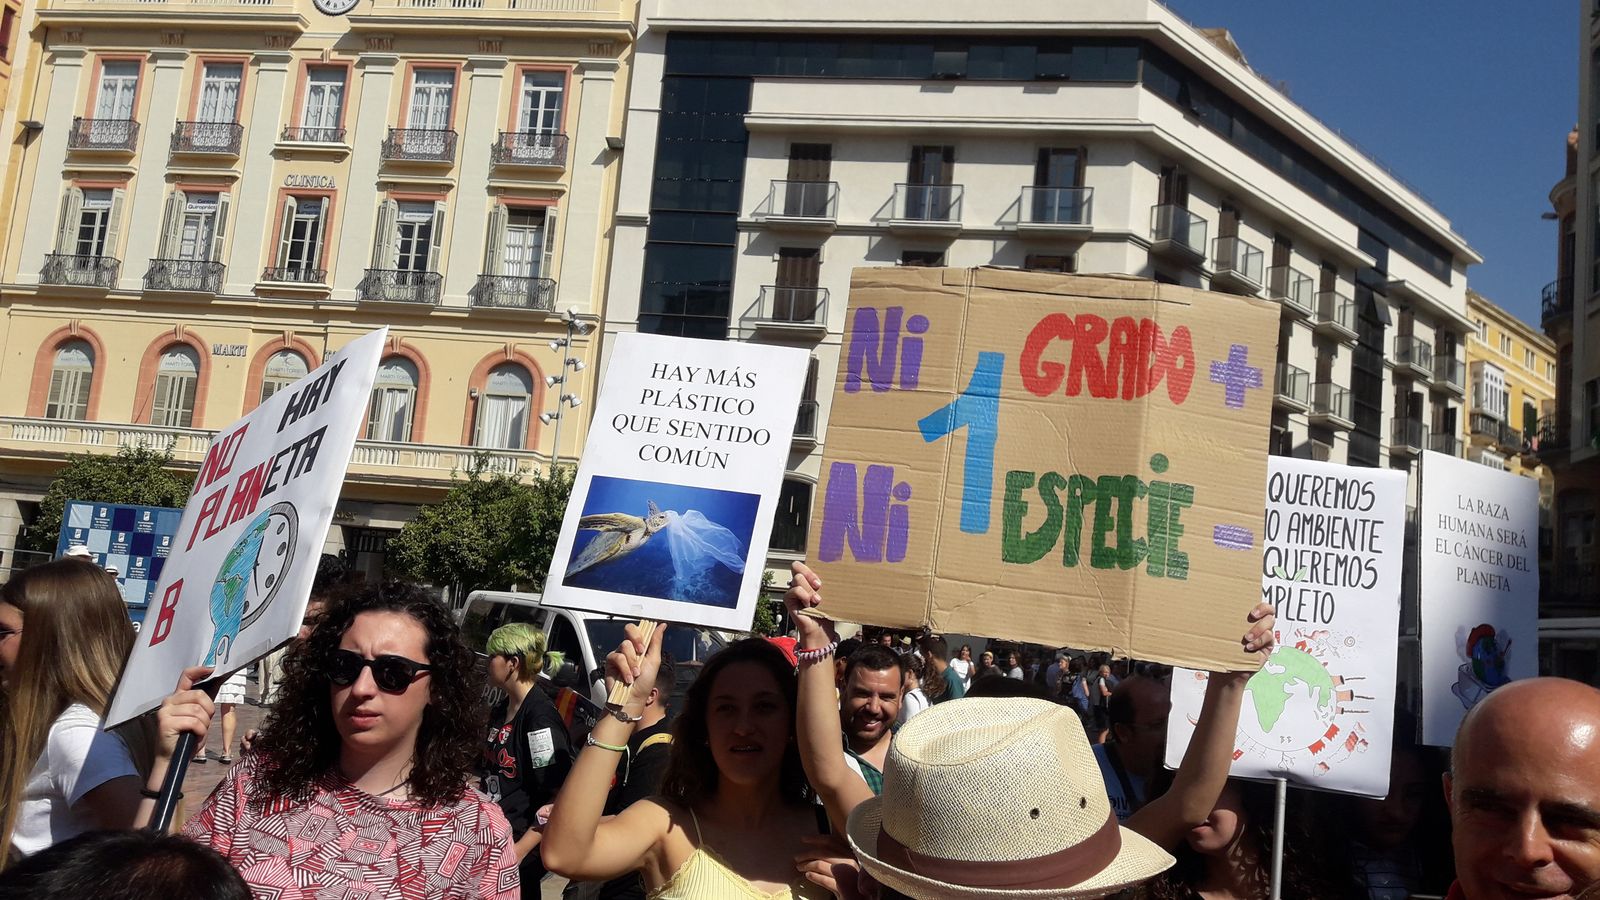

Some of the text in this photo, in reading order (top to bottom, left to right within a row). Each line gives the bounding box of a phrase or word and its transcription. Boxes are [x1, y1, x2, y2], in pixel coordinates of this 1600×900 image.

[284, 174, 336, 189] CLINICA
[212, 343, 248, 357] MARTI
[650, 362, 758, 389] HAY MÁS
[639, 387, 755, 416] PLÁSTICO
[193, 357, 349, 497] NO HAY
[612, 413, 771, 446] QUE SENTIDO
[917, 351, 1005, 535] 1
[1019, 312, 1196, 406] GRADO
[638, 443, 731, 470] COMÚN
[1268, 471, 1376, 512] QUEREMOS
[1457, 494, 1510, 521] LA RAZA
[1287, 512, 1384, 554] AMBIENTE
[1438, 513, 1527, 549] HUMANA SERÁ
[1263, 546, 1378, 590] QUEREMOS
[1435, 537, 1531, 573] EL CÁNCER DEL
[1456, 566, 1511, 592] PLANETA
[148, 578, 184, 648] B
[1262, 585, 1335, 625] MPLETO
